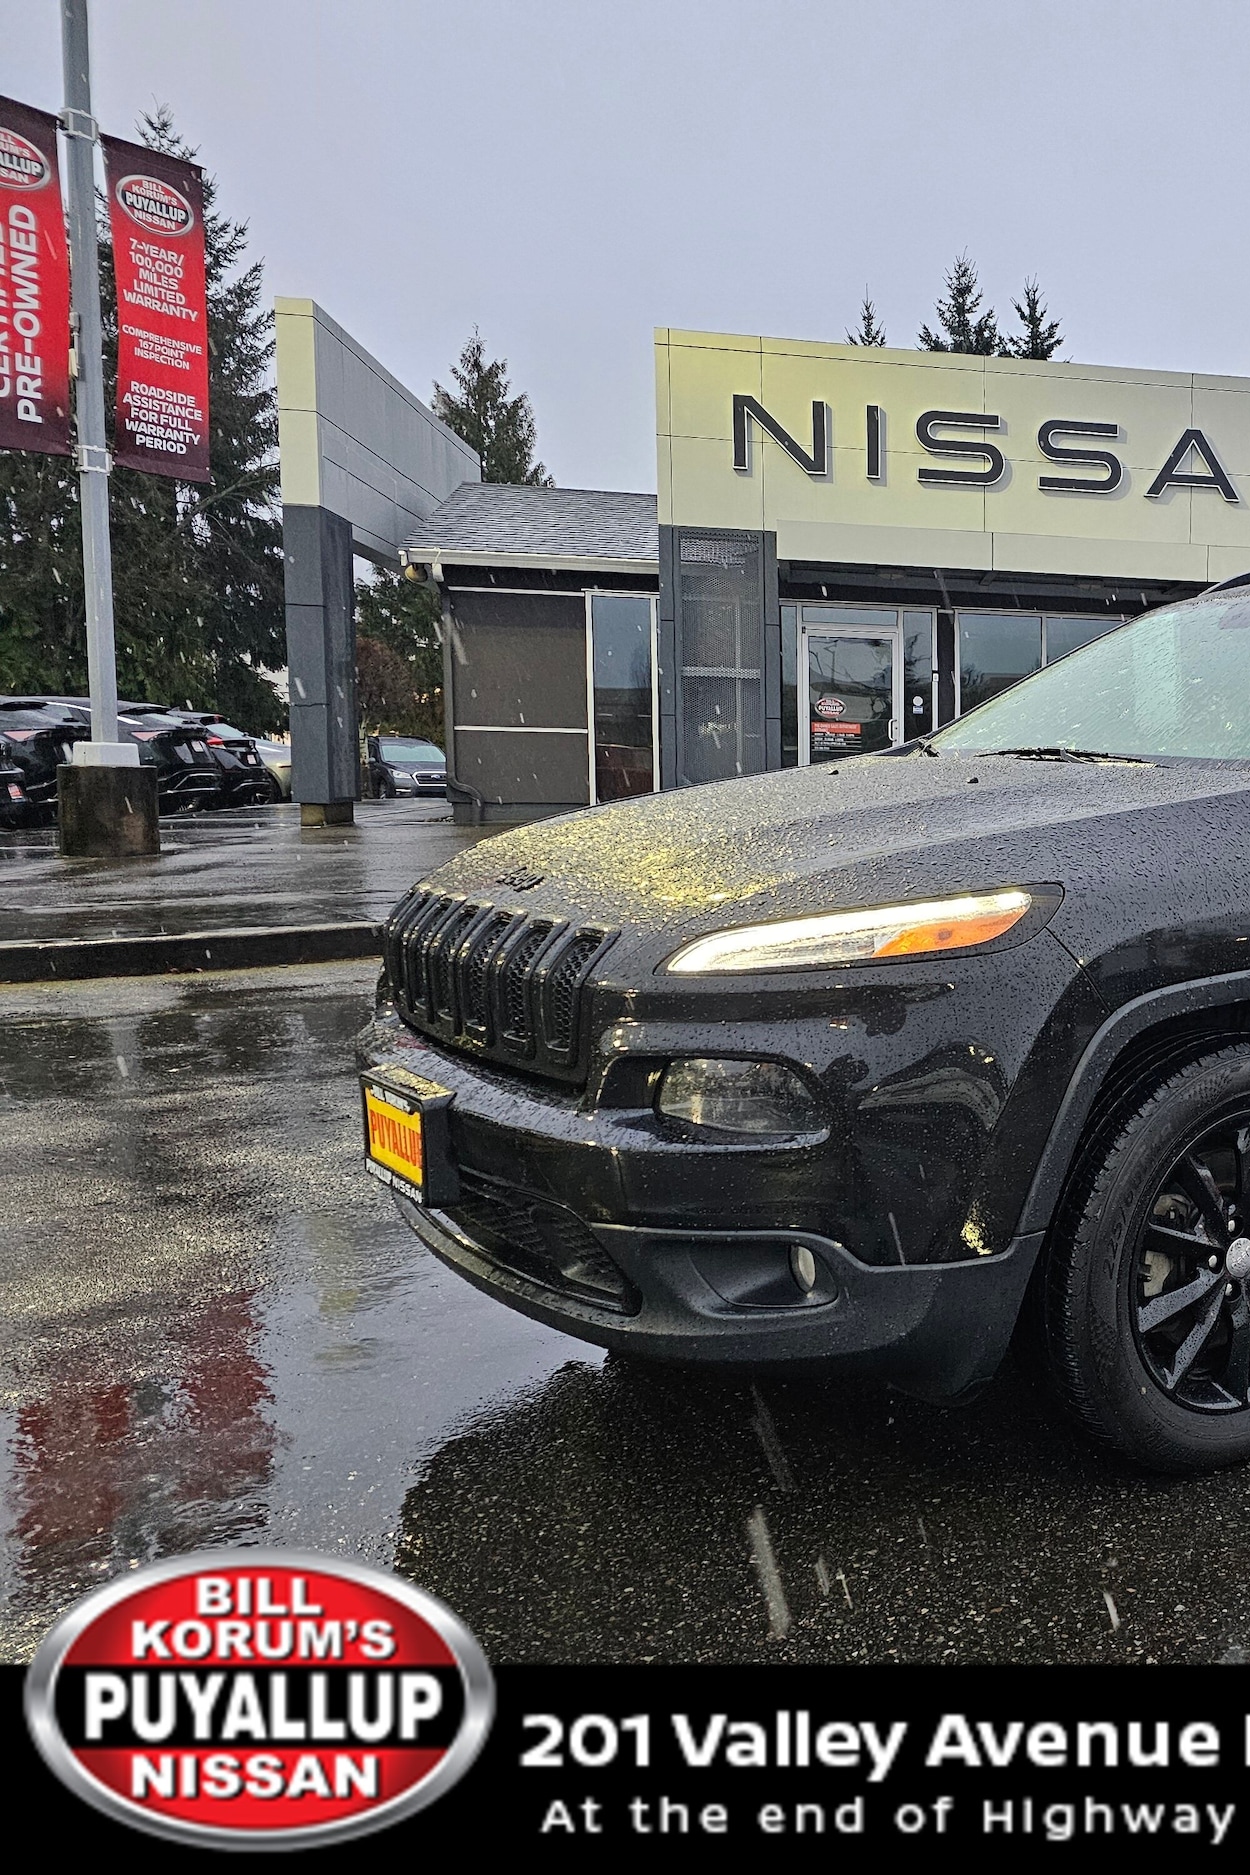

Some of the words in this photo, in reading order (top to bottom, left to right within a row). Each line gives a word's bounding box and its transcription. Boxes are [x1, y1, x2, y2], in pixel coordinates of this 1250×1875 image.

[132, 184, 177, 206] KORUM'S
[142, 180, 165, 194] BILL
[125, 191, 186, 222] PUYALLUP
[133, 209, 176, 230] NISSAN
[129, 237, 184, 266] 7-YEAR/
[129, 251, 183, 278] 100,000
[133, 279, 186, 305] LIMITED
[139, 268, 178, 290] MILES
[8, 204, 43, 424] PRE-OWNED
[123, 289, 198, 322] WARRANTY
[122, 324, 202, 355] COMPREHENSIVE
[139, 339, 154, 350] 167
[154, 344, 185, 360] POINT
[134, 347, 190, 370] INSPECTION
[122, 392, 203, 421] ASSISTANCE
[131, 380, 196, 407] ROADSIDE
[125, 418, 200, 445] WARRANTY
[131, 407, 158, 424] FOR
[160, 414, 193, 431] FULL
[136, 434, 187, 455] PERIOD
